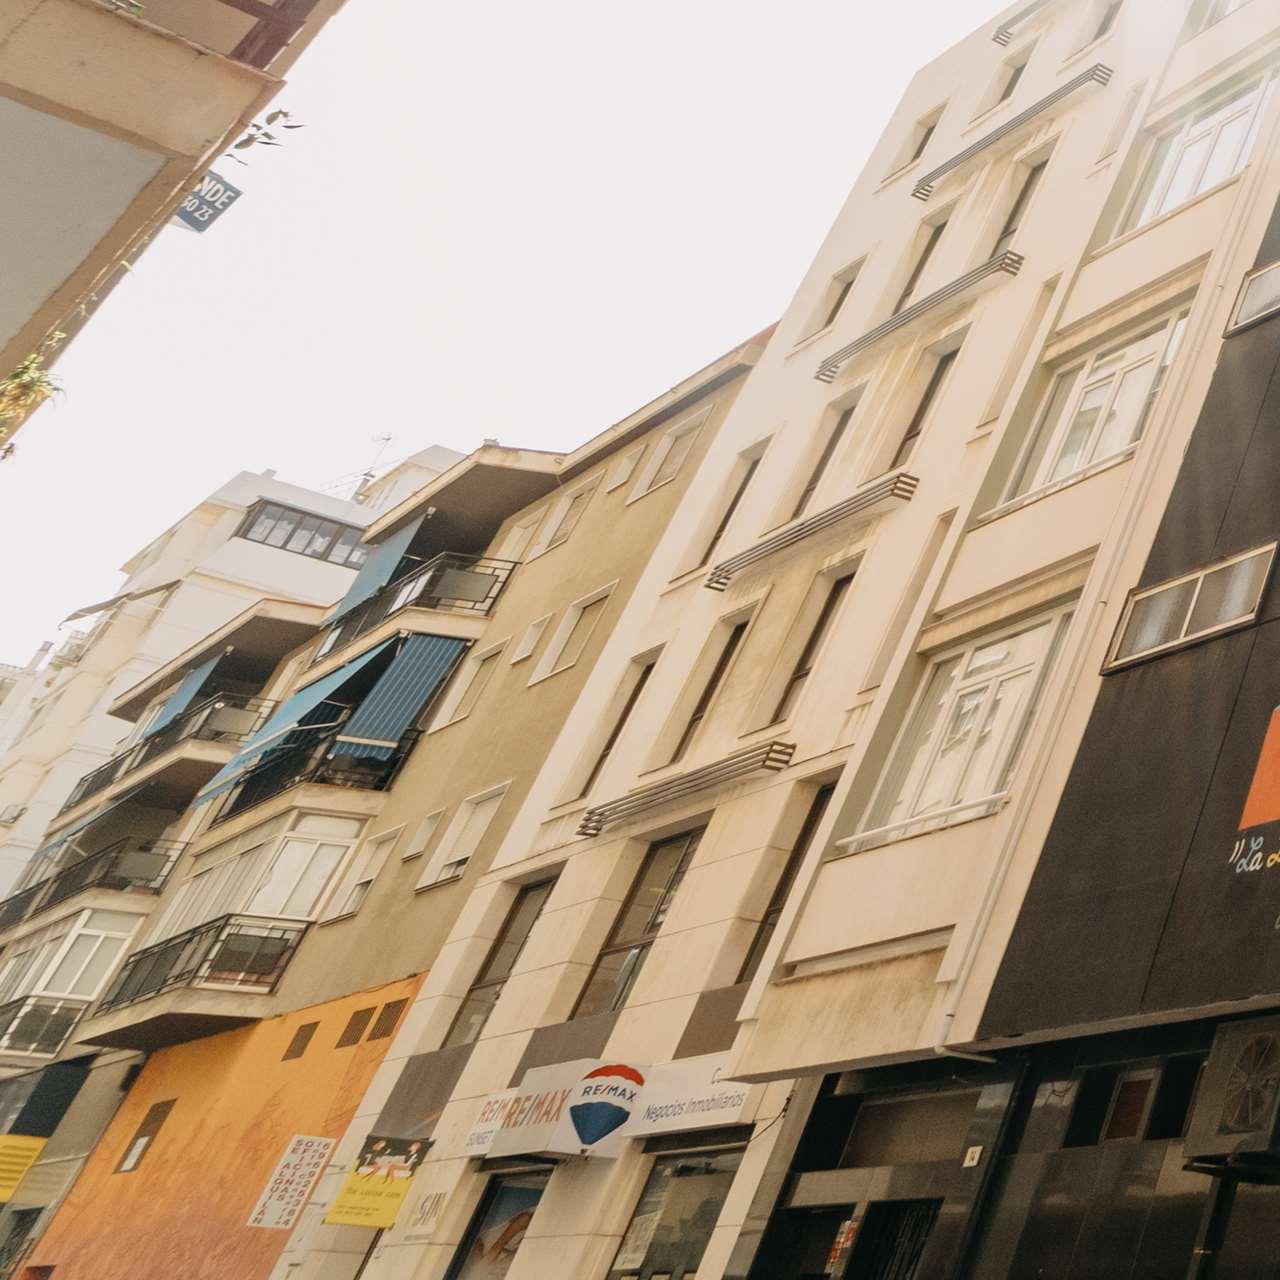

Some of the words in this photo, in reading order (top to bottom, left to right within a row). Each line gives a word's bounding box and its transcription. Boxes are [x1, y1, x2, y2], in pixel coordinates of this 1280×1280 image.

[193, 204, 214, 221] 23
[582, 1084, 638, 1103] RE/MAX
[501, 1087, 573, 1129] RE/MAX
[641, 1100, 687, 1123] Negocios
[686, 1091, 746, 1116] Inmobiliarios
